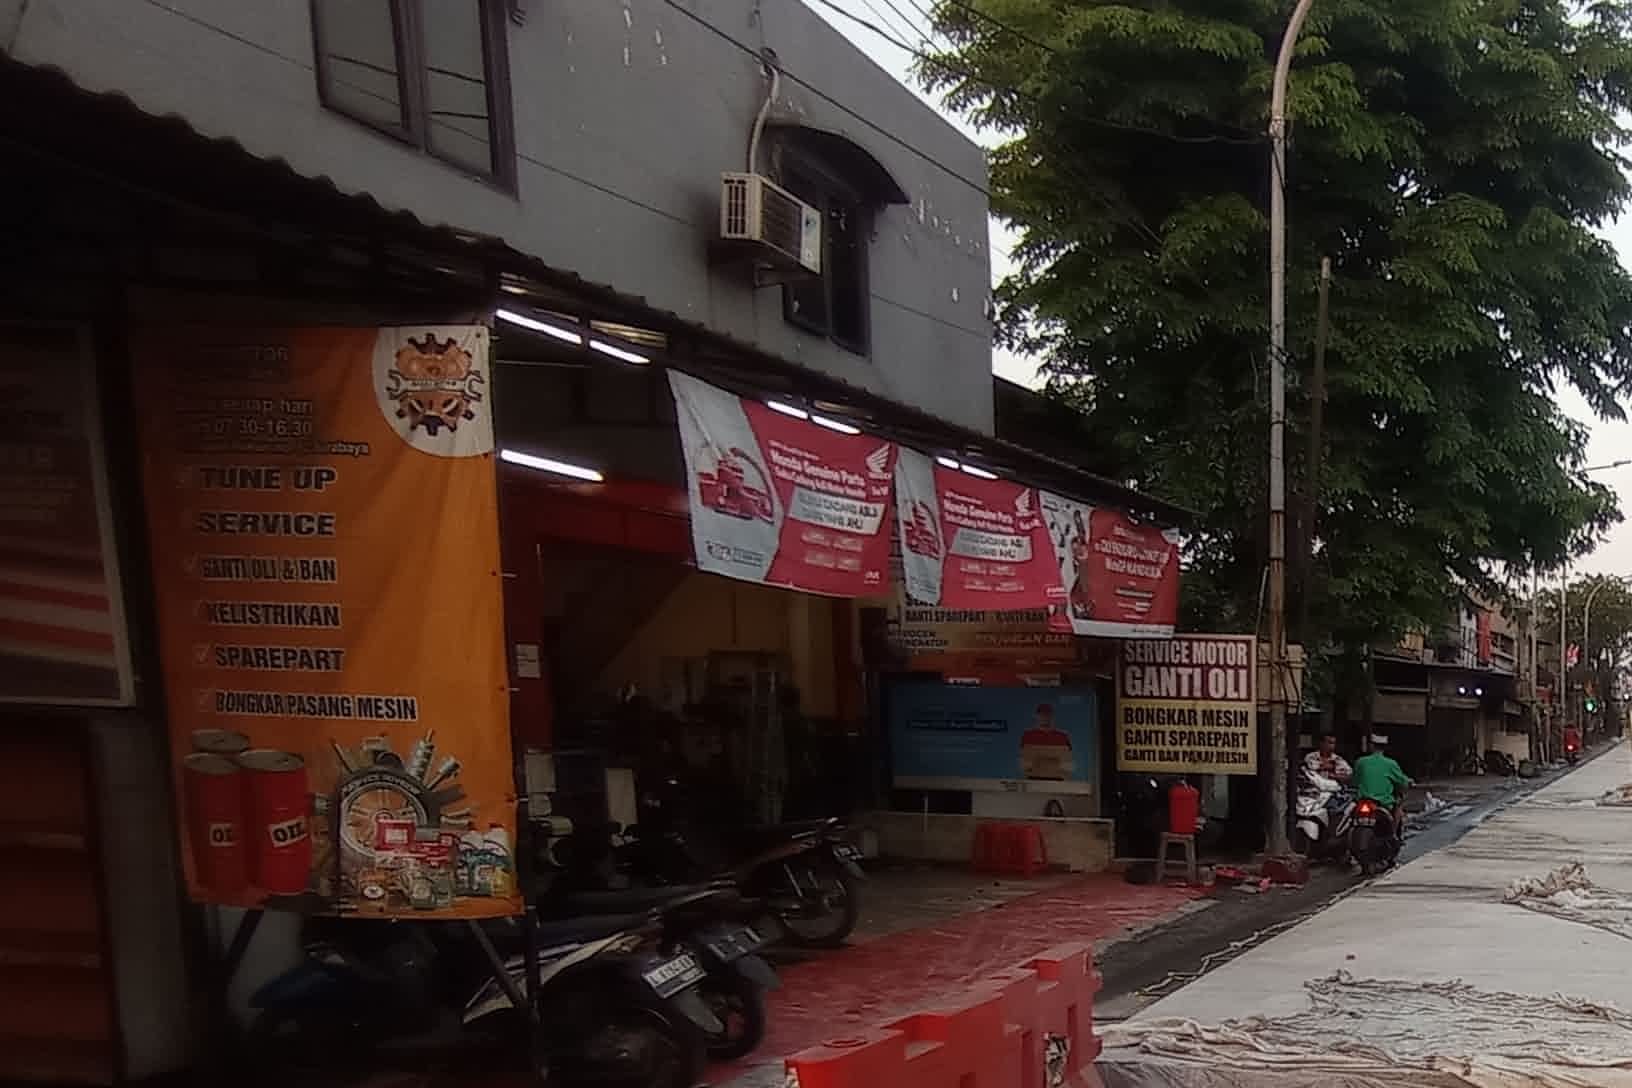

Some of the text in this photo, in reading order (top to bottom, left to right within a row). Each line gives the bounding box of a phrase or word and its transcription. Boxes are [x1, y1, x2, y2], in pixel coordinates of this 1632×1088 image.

[199, 466, 336, 491] TUNE UP
[196, 512, 337, 536] SERVICE
[201, 555, 247, 580] GANTI
[250, 556, 276, 581] OLI
[299, 557, 338, 583] BAN
[208, 601, 342, 628] KELISTRIKAN
[214, 645, 344, 671] SPAREPART
[1126, 640, 1248, 666] SERVICE MOTOR
[1126, 665, 1248, 699] GANTI OLI
[216, 690, 417, 721] BONGKAR PASANG MESIN
[1125, 707, 1248, 728] BONGKAR MESIN
[1124, 730, 1248, 748] GANTI SPAREPART
[1125, 749, 1156, 762] GANTI
[1158, 750, 1179, 762] BAN
[1216, 751, 1248, 763] MESIN
[273, 820, 305, 844] OIL
